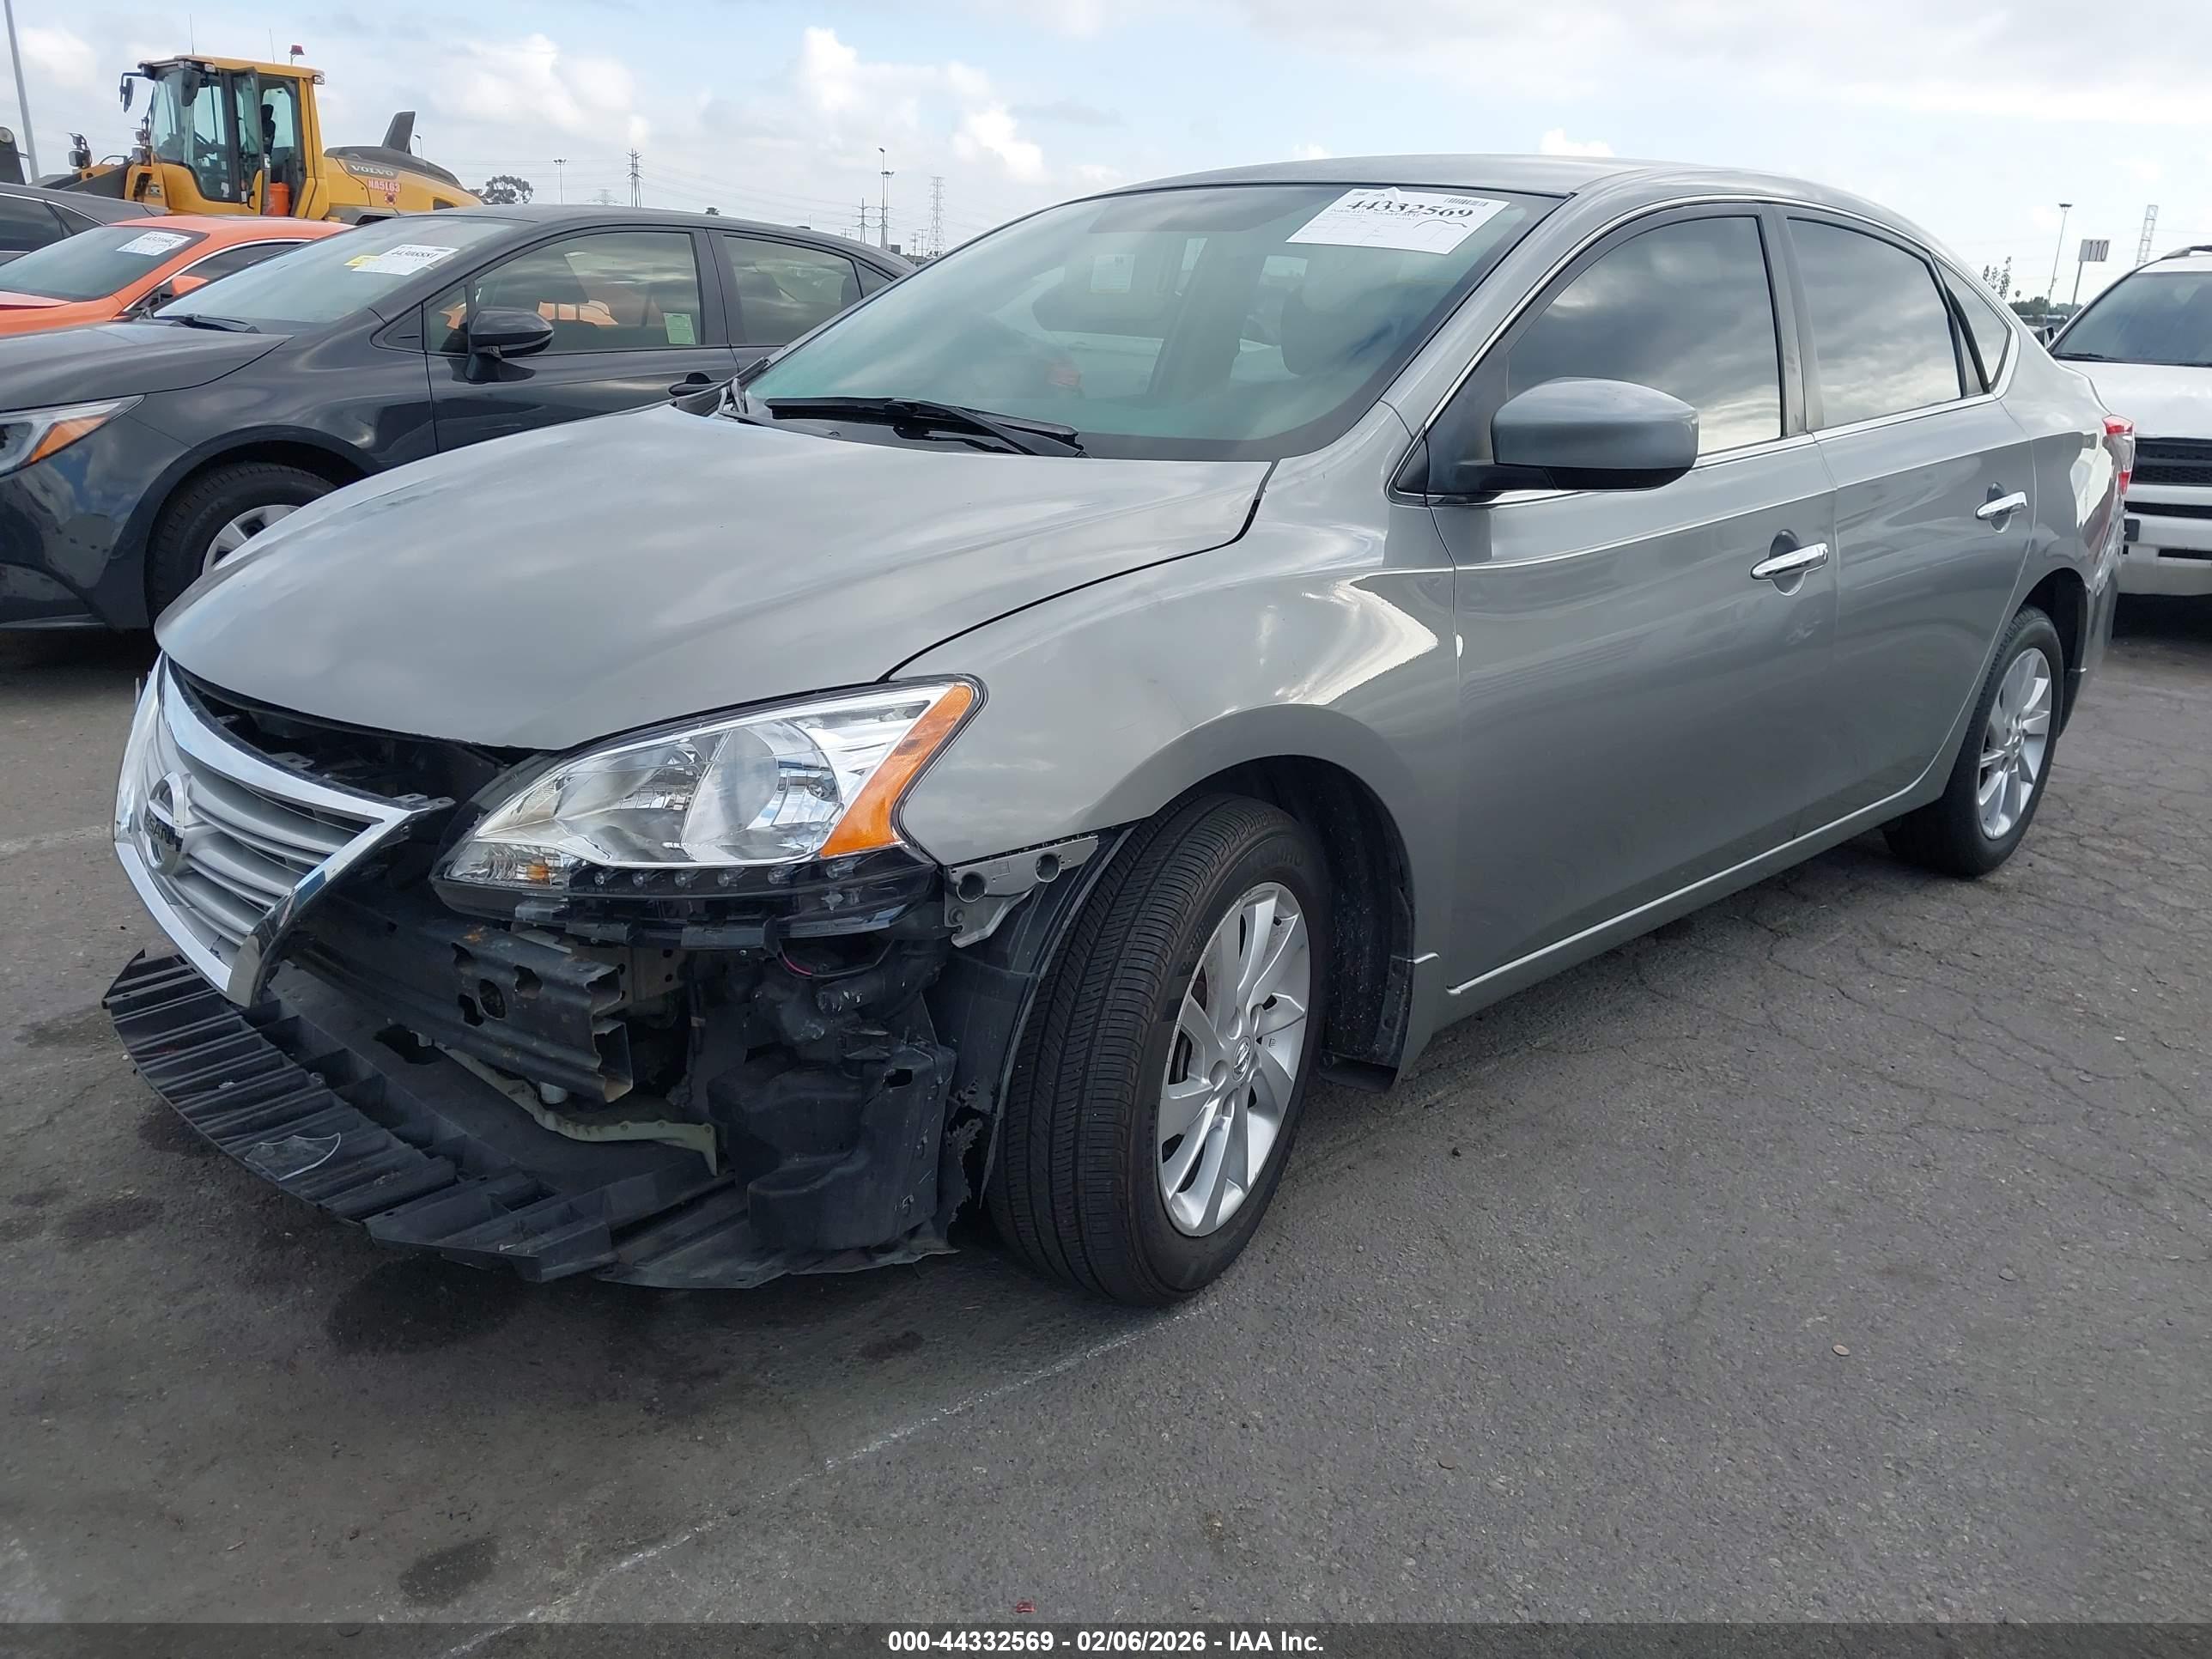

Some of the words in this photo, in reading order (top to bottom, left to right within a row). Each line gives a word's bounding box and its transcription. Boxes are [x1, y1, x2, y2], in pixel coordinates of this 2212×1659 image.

[350, 164, 394, 176] VOLVO
[1346, 200, 1474, 218] 44332569
[2087, 240, 2109, 262] 110
